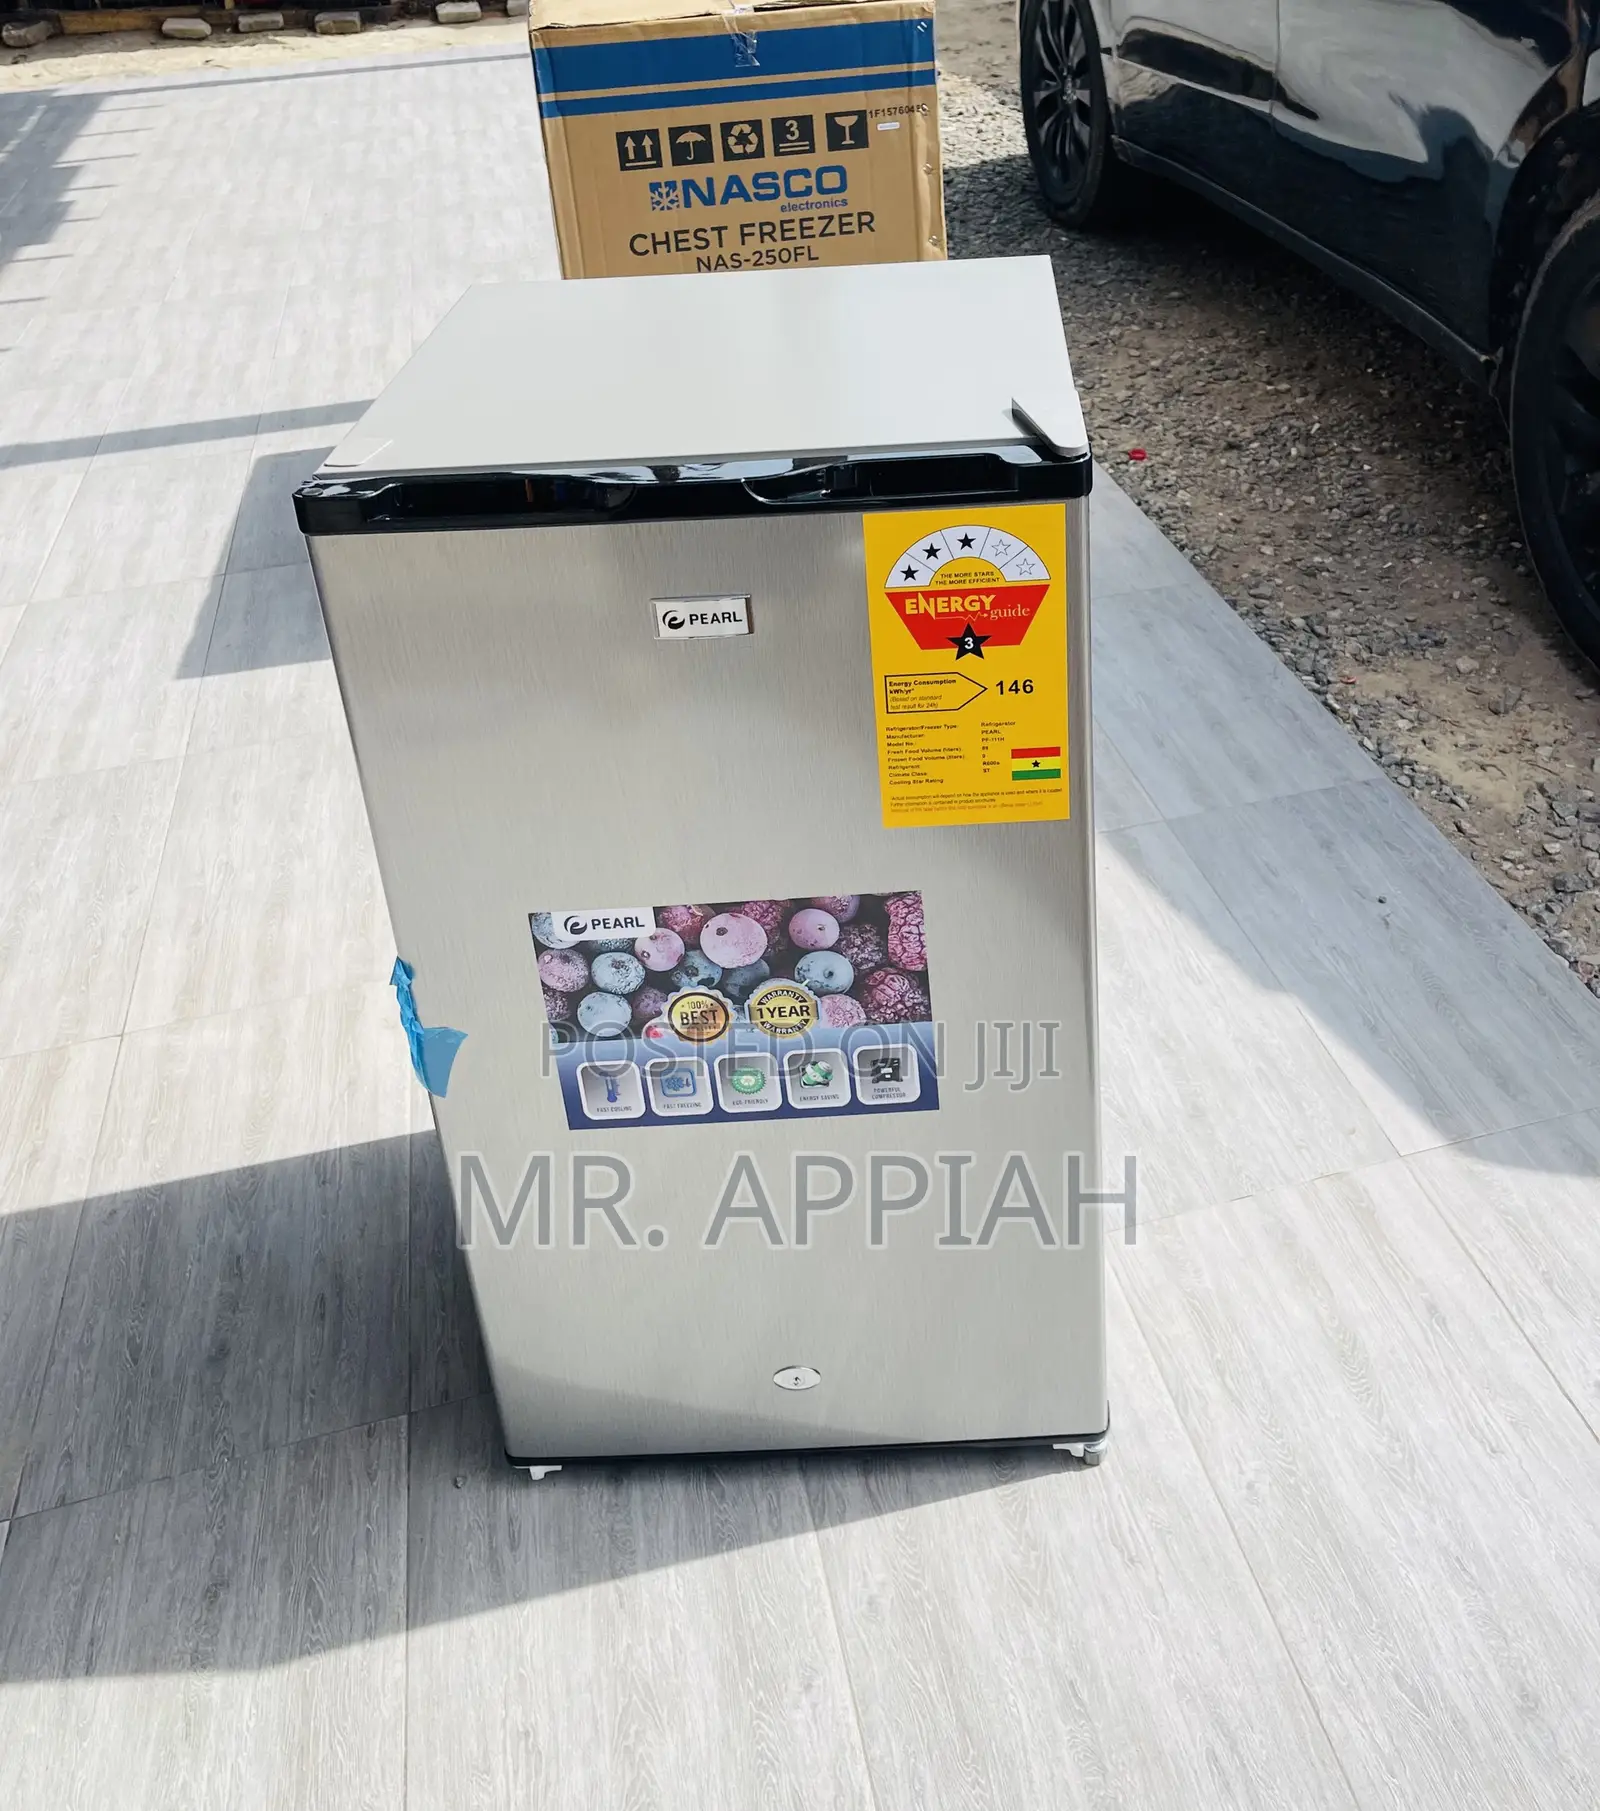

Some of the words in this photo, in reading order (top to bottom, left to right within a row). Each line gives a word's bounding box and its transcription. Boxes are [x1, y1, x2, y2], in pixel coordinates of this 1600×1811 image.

[785, 120, 799, 140] 3
[681, 165, 848, 208] NASCO
[780, 198, 848, 213] electronics
[629, 225, 728, 257] CHEST
[740, 211, 876, 246] FREEZER
[696, 245, 819, 272] NAS-250FL
[905, 592, 996, 620] ENERGY
[990, 603, 1030, 621] guide
[689, 611, 743, 625] PEARL
[964, 637, 974, 650] 3
[995, 679, 1034, 695] 146
[591, 916, 645, 930] PEARL
[761, 989, 804, 1004] WARRANTY
[686, 1000, 708, 1010] 100%
[680, 1009, 718, 1026] BEST
[763, 1019, 807, 1035] WARRANTY
